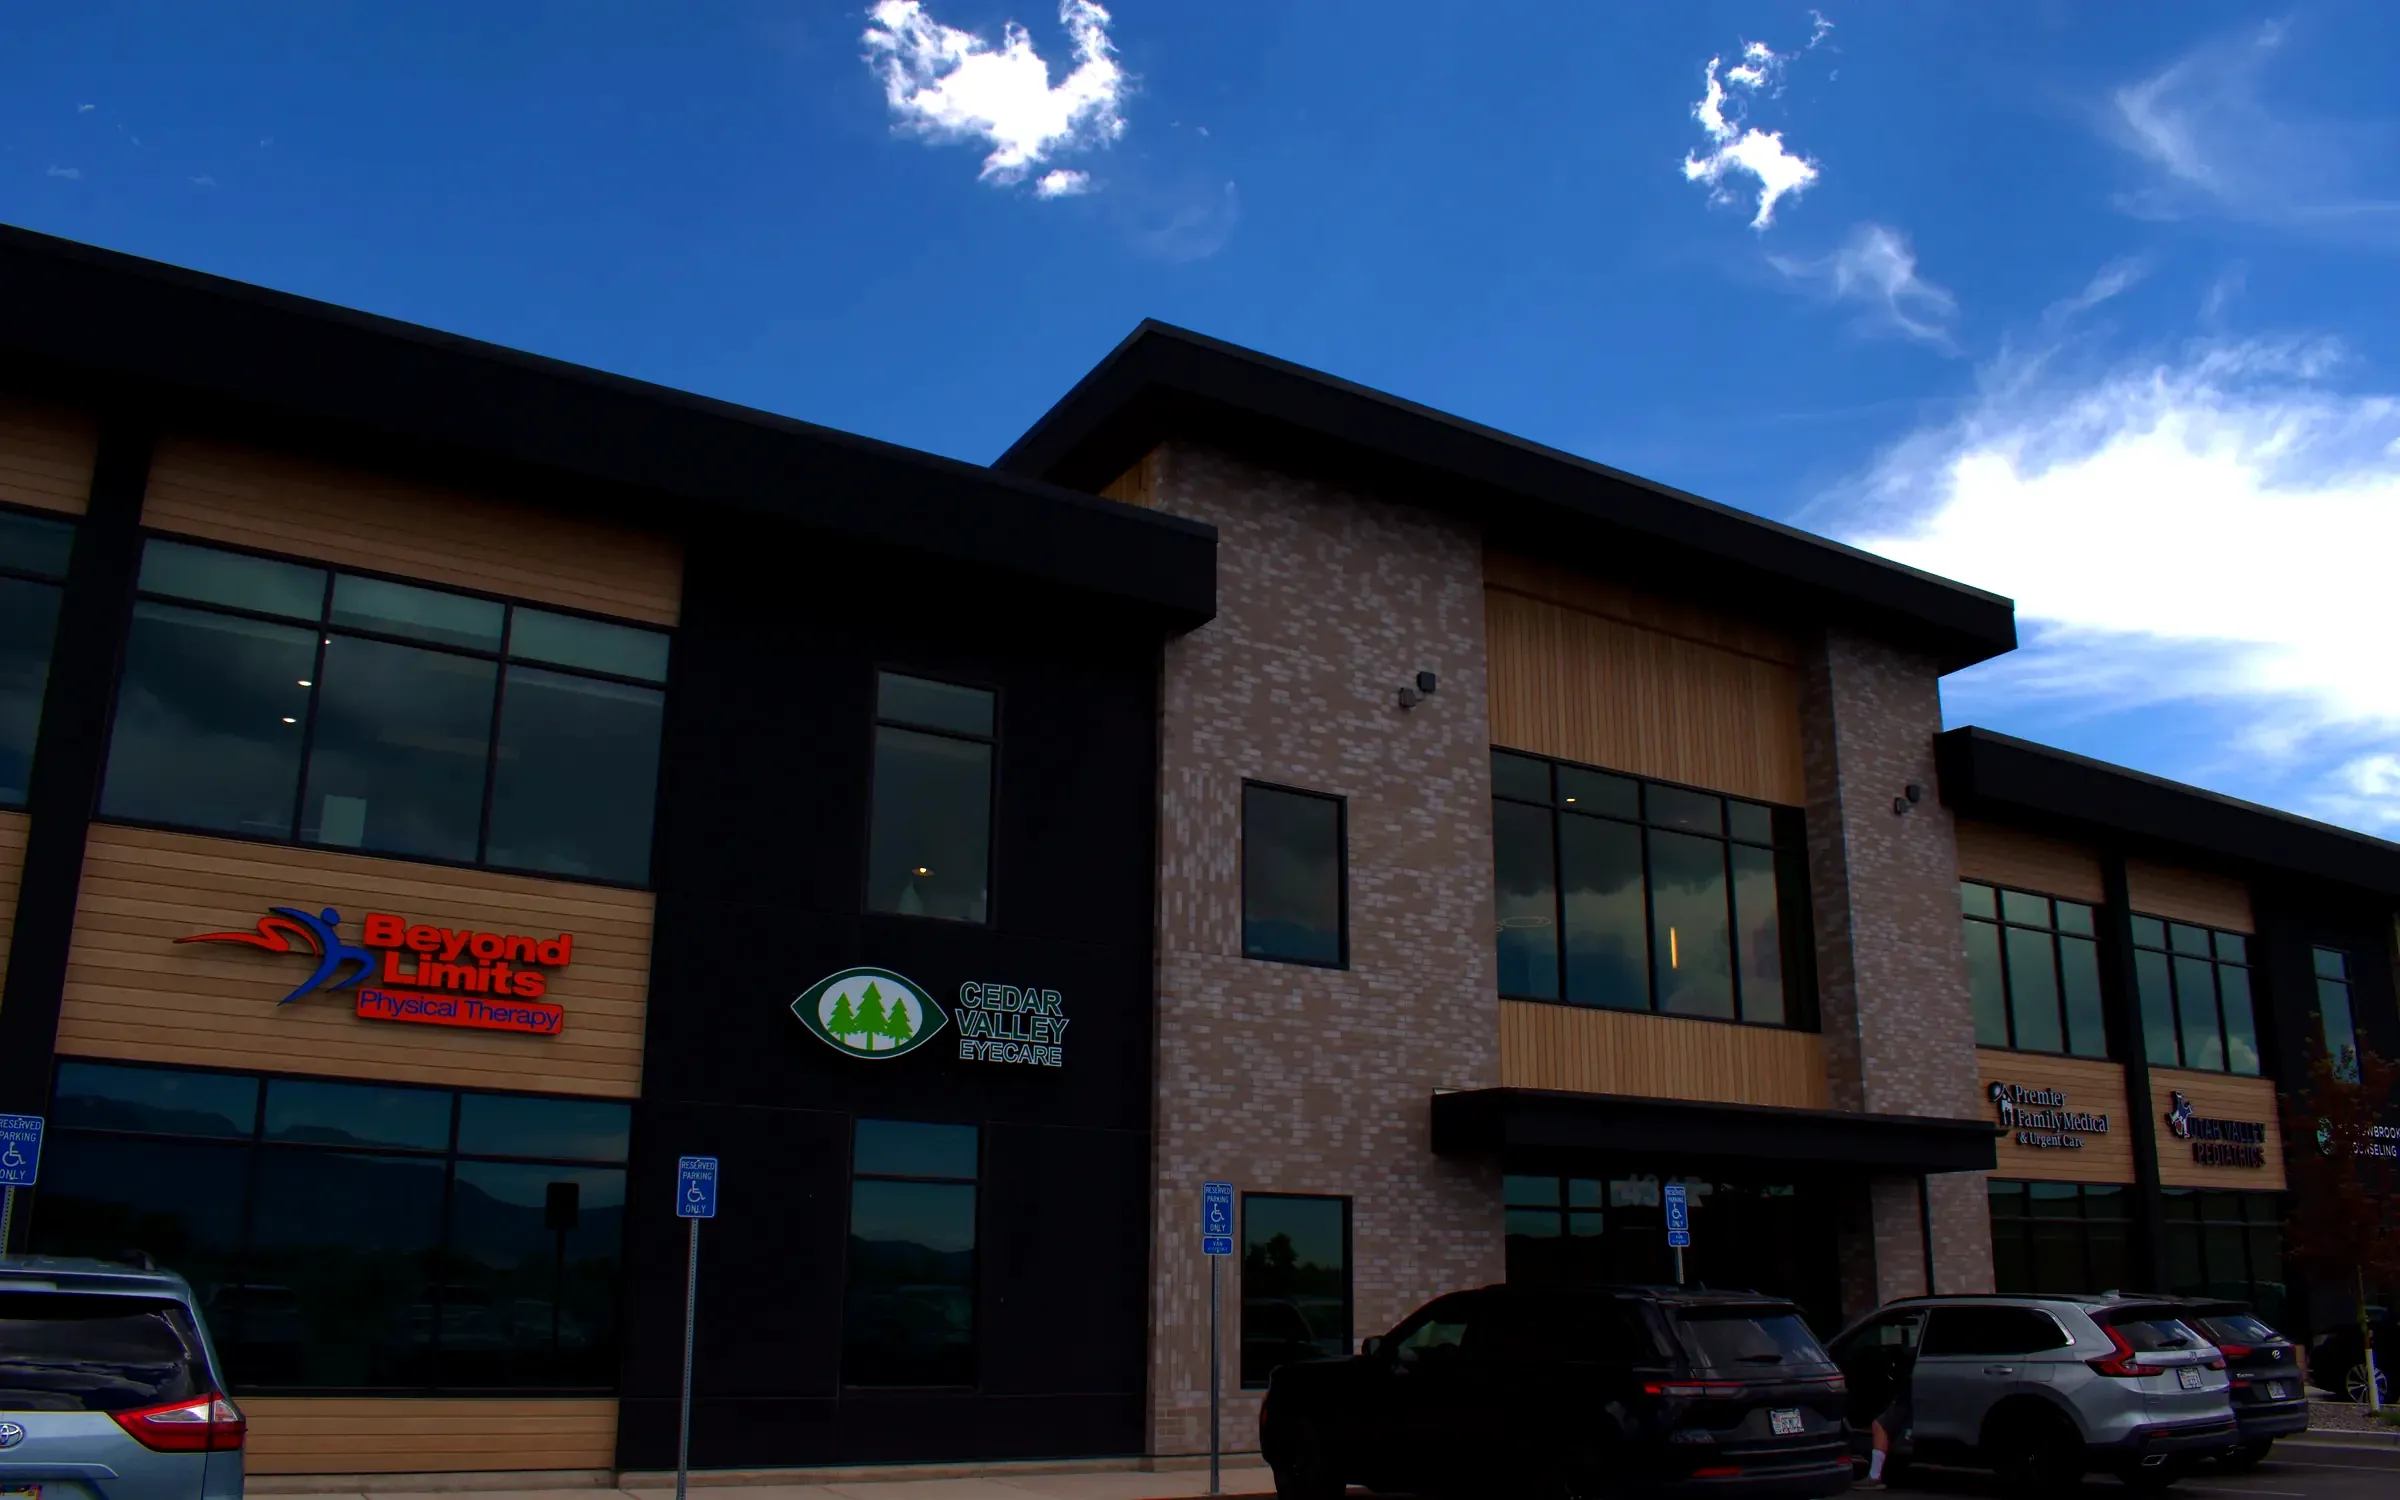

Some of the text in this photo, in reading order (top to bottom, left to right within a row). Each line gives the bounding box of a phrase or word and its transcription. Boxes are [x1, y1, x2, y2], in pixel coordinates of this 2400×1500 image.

[364, 913, 573, 967] Beyond
[383, 950, 546, 998] Limits
[360, 990, 560, 1031] Physical Therapy
[960, 981, 1063, 1017] CEDAR
[955, 1008, 1070, 1044] VALLEY
[959, 1038, 1062, 1067] EYECARE
[2014, 1084, 2067, 1107] Premier
[2018, 1109, 2110, 1133] Family Medical
[2018, 1132, 2085, 1148] & Urgent Care
[681, 1160, 715, 1170] RESERVED
[2193, 1142, 2267, 1168] PEDIATRICS
[0, 1169, 26, 1180] ONLY
[682, 1171, 713, 1181] PARKING
[685, 1203, 707, 1214] ONLY
